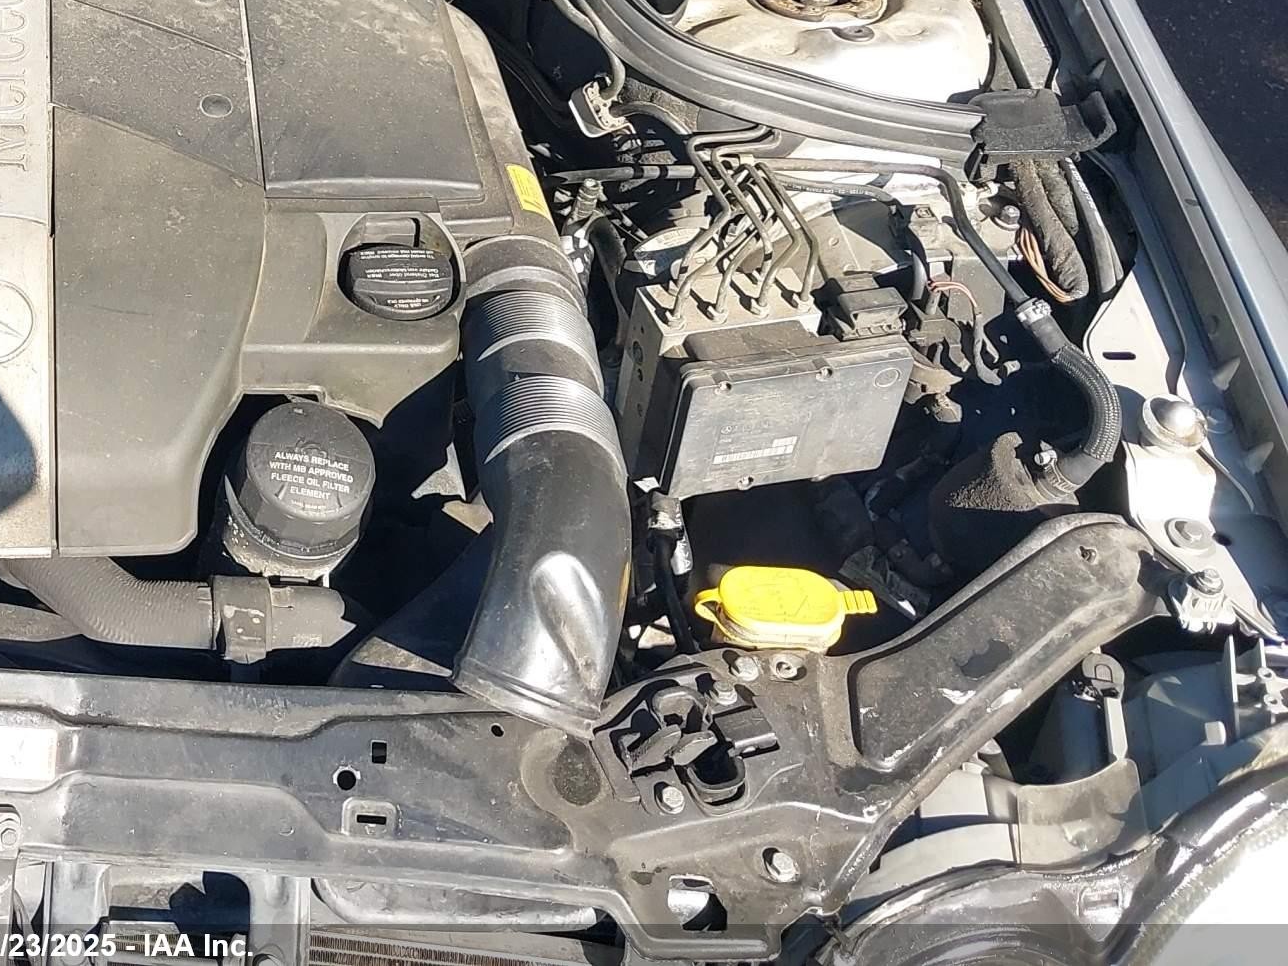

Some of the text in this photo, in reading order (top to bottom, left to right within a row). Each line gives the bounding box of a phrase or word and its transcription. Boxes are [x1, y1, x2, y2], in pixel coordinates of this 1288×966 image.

[274, 451, 349, 471] ALWAYS REPLACE
[269, 461, 353, 483] WITH MB APPROVED
[271, 473, 350, 494] FLEECE OIL FILTER
[290, 486, 331, 500] ELEMENT
